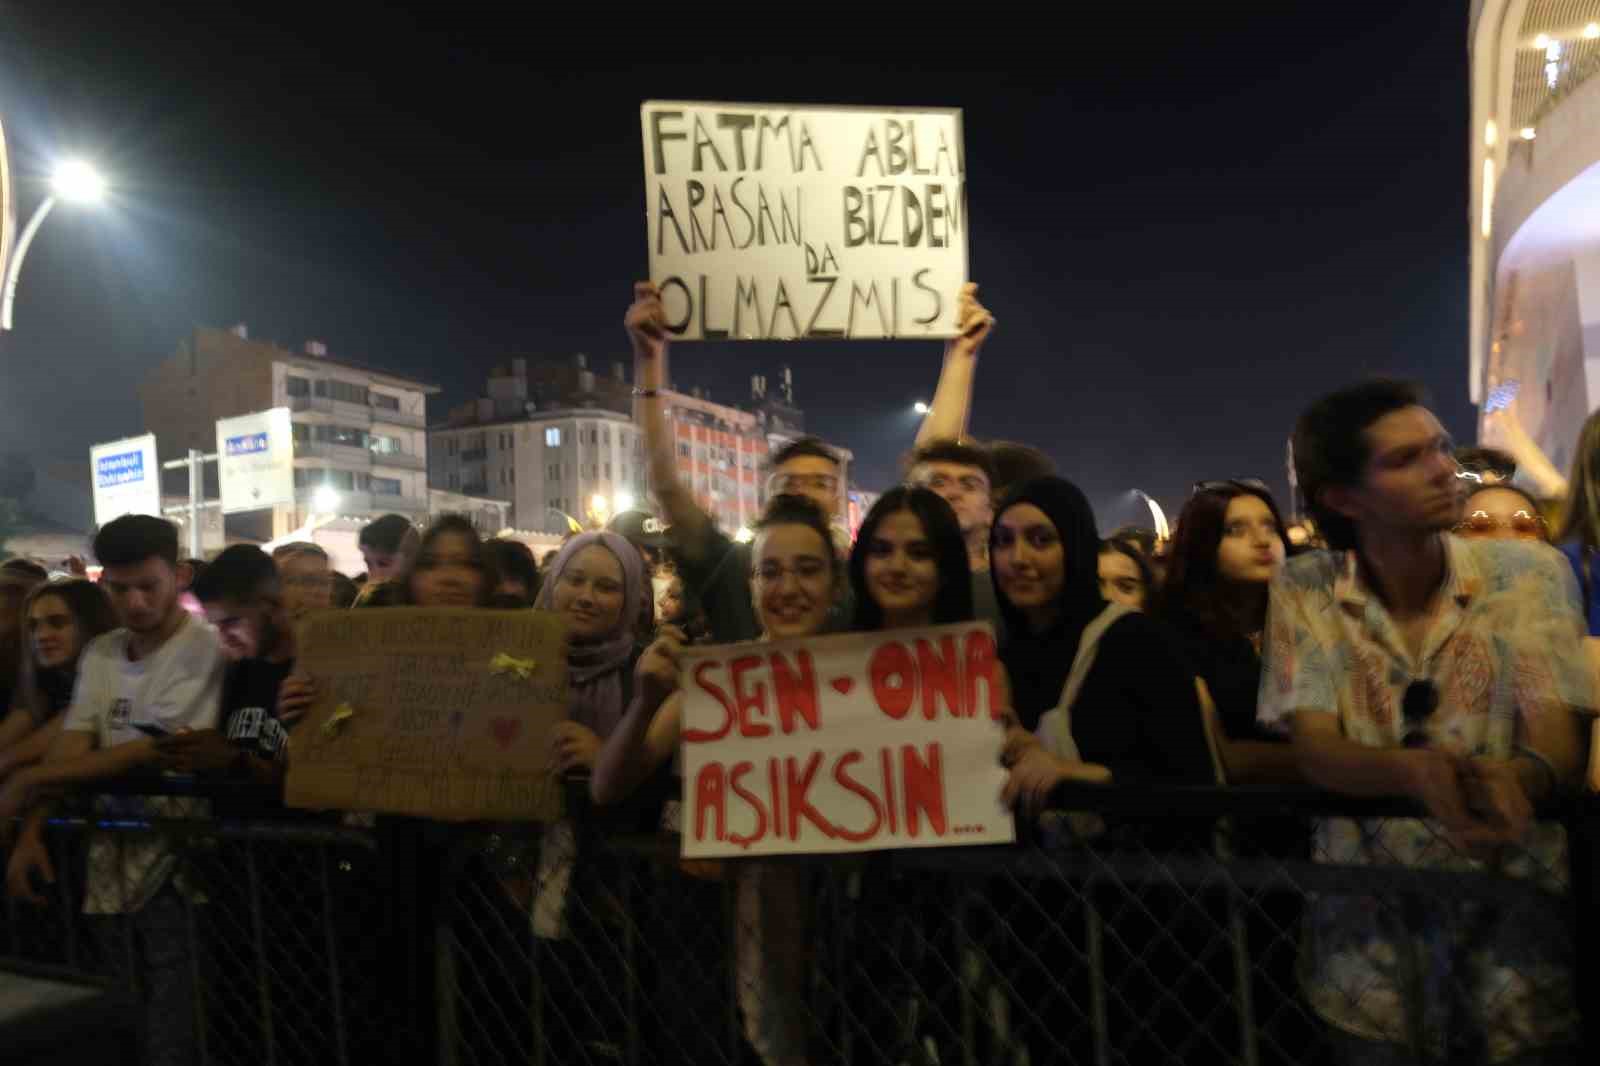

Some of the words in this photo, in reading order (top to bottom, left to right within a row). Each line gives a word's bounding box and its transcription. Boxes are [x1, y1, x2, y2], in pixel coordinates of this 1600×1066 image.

[650, 110, 823, 175] FATMA
[857, 119, 956, 177] ABLA
[656, 177, 801, 255] ARASAN
[803, 241, 840, 275] DA
[681, 646, 823, 743] SEN
[866, 630, 1002, 721] ONA
